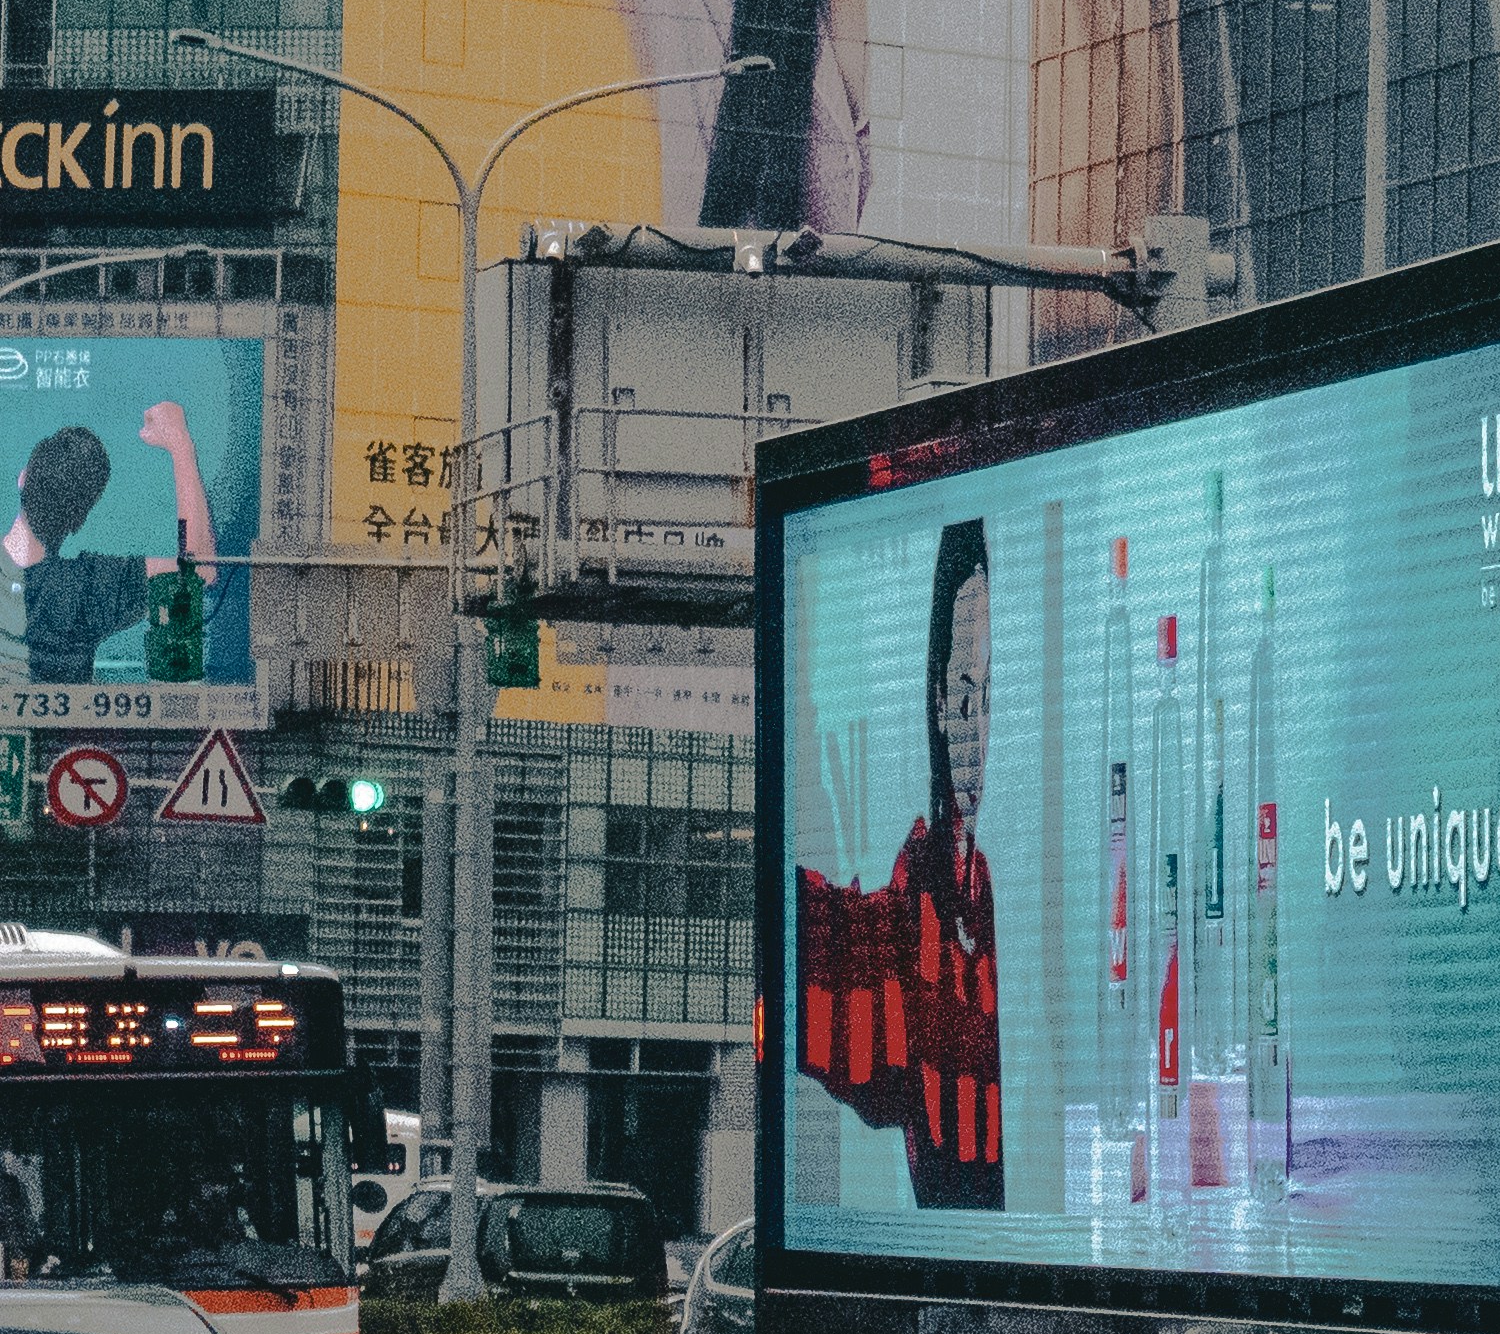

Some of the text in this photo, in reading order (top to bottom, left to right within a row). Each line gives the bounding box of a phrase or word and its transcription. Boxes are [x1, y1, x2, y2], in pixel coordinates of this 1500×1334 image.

[0, 121, 92, 190] CK
[1481, 581, 1496, 607] be
[1324, 797, 1368, 894] be
